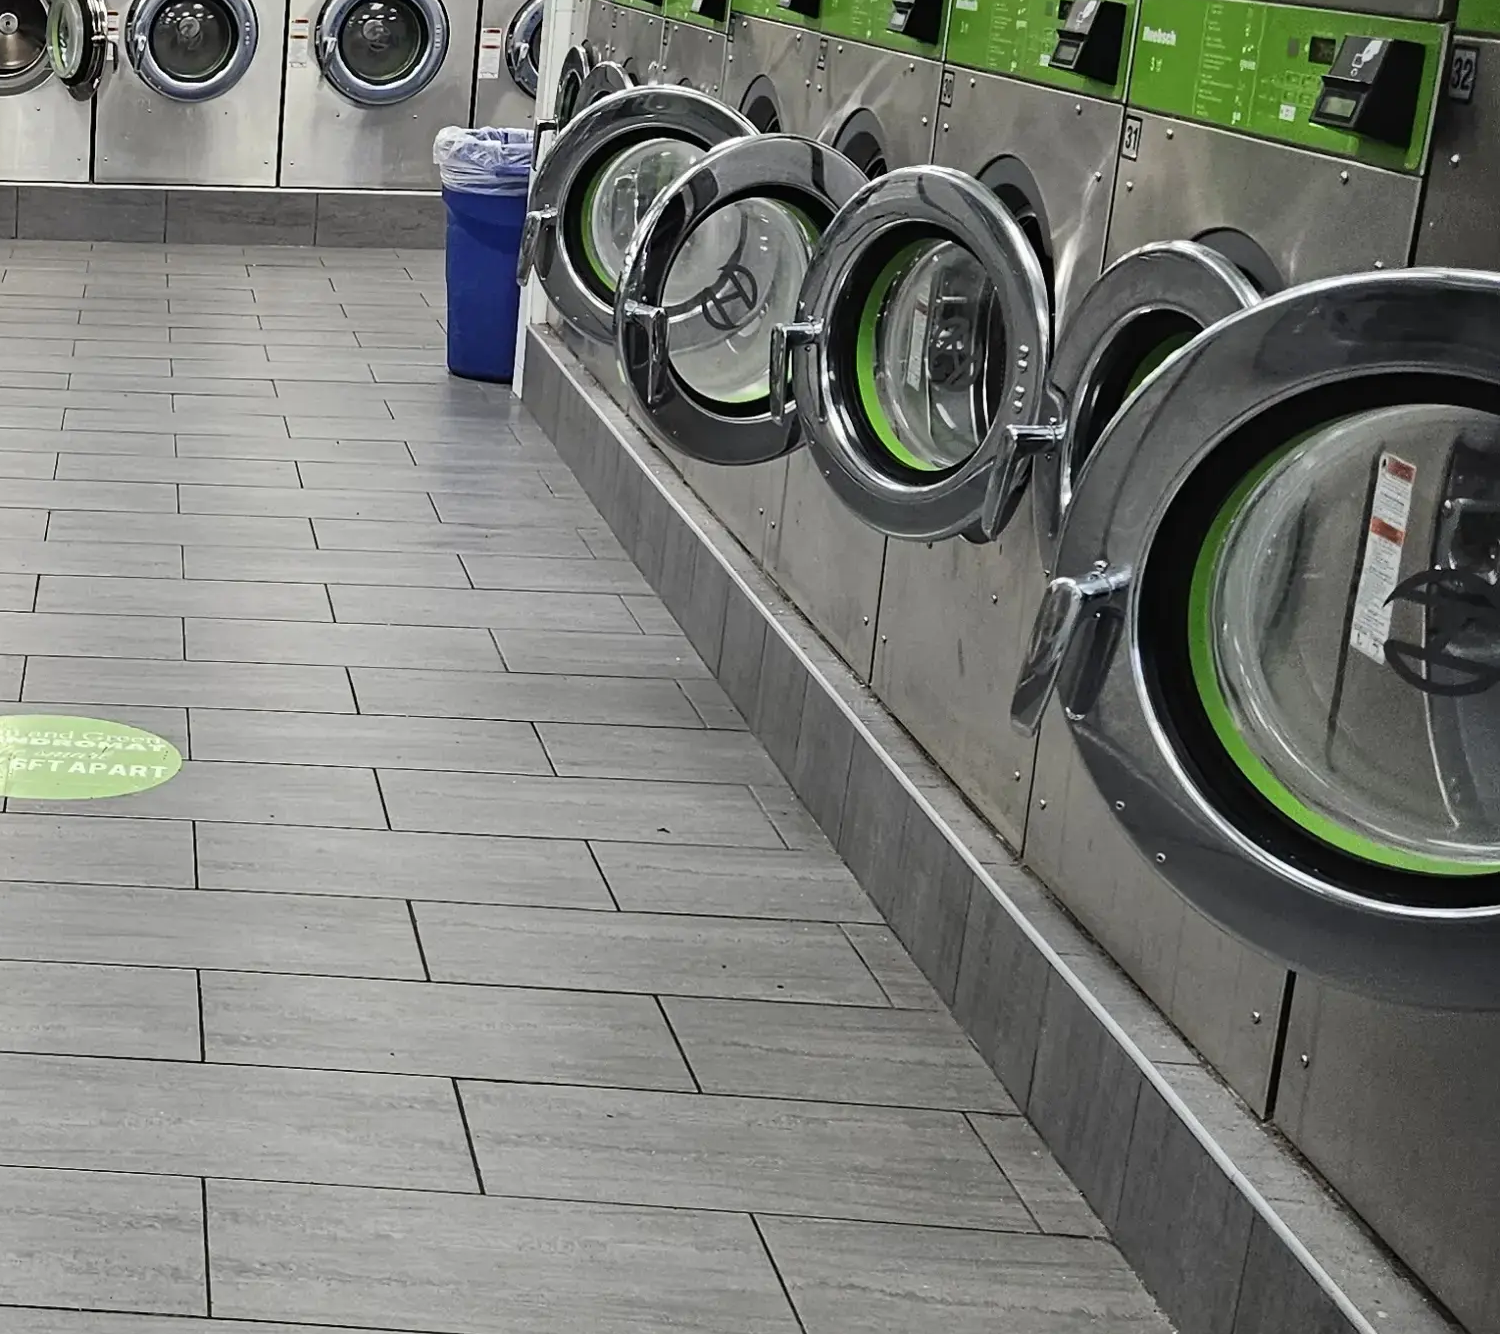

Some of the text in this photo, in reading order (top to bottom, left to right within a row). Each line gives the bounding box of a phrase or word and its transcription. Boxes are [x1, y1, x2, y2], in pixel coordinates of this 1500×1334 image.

[1451, 57, 1474, 91] 32
[1125, 125, 1138, 150] 31
[28, 729, 73, 740] and
[83, 731, 162, 745] Green
[11, 755, 64, 773] 6FT
[68, 761, 169, 779] APART
